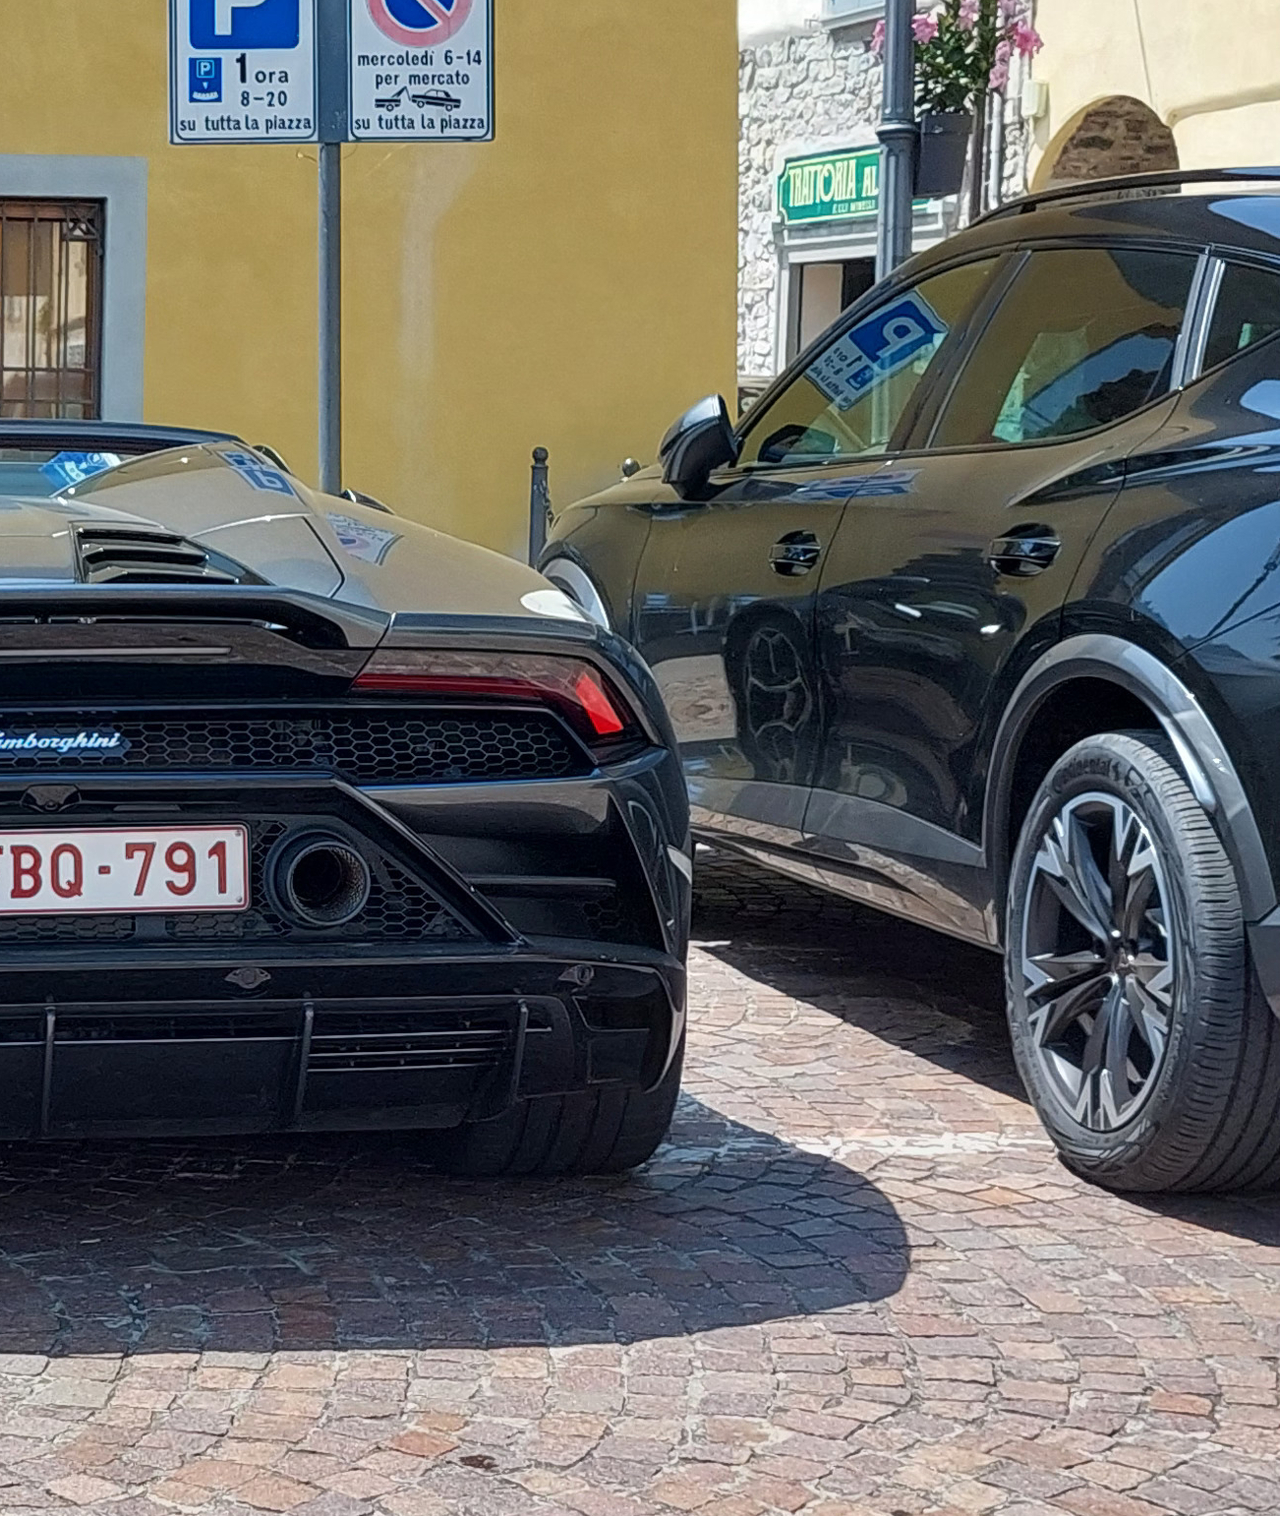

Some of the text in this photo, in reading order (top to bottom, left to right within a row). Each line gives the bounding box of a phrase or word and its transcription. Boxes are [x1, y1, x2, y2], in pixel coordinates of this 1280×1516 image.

[444, 50, 482, 65] 6-14
[235, 53, 289, 84] 1 ora
[375, 70, 470, 90] per mercato
[241, 90, 287, 107] 8-20
[180, 114, 312, 134] su tutta la piazza
[354, 114, 485, 134] su tutta la piazza
[788, 159, 857, 207] TRATTORIA
